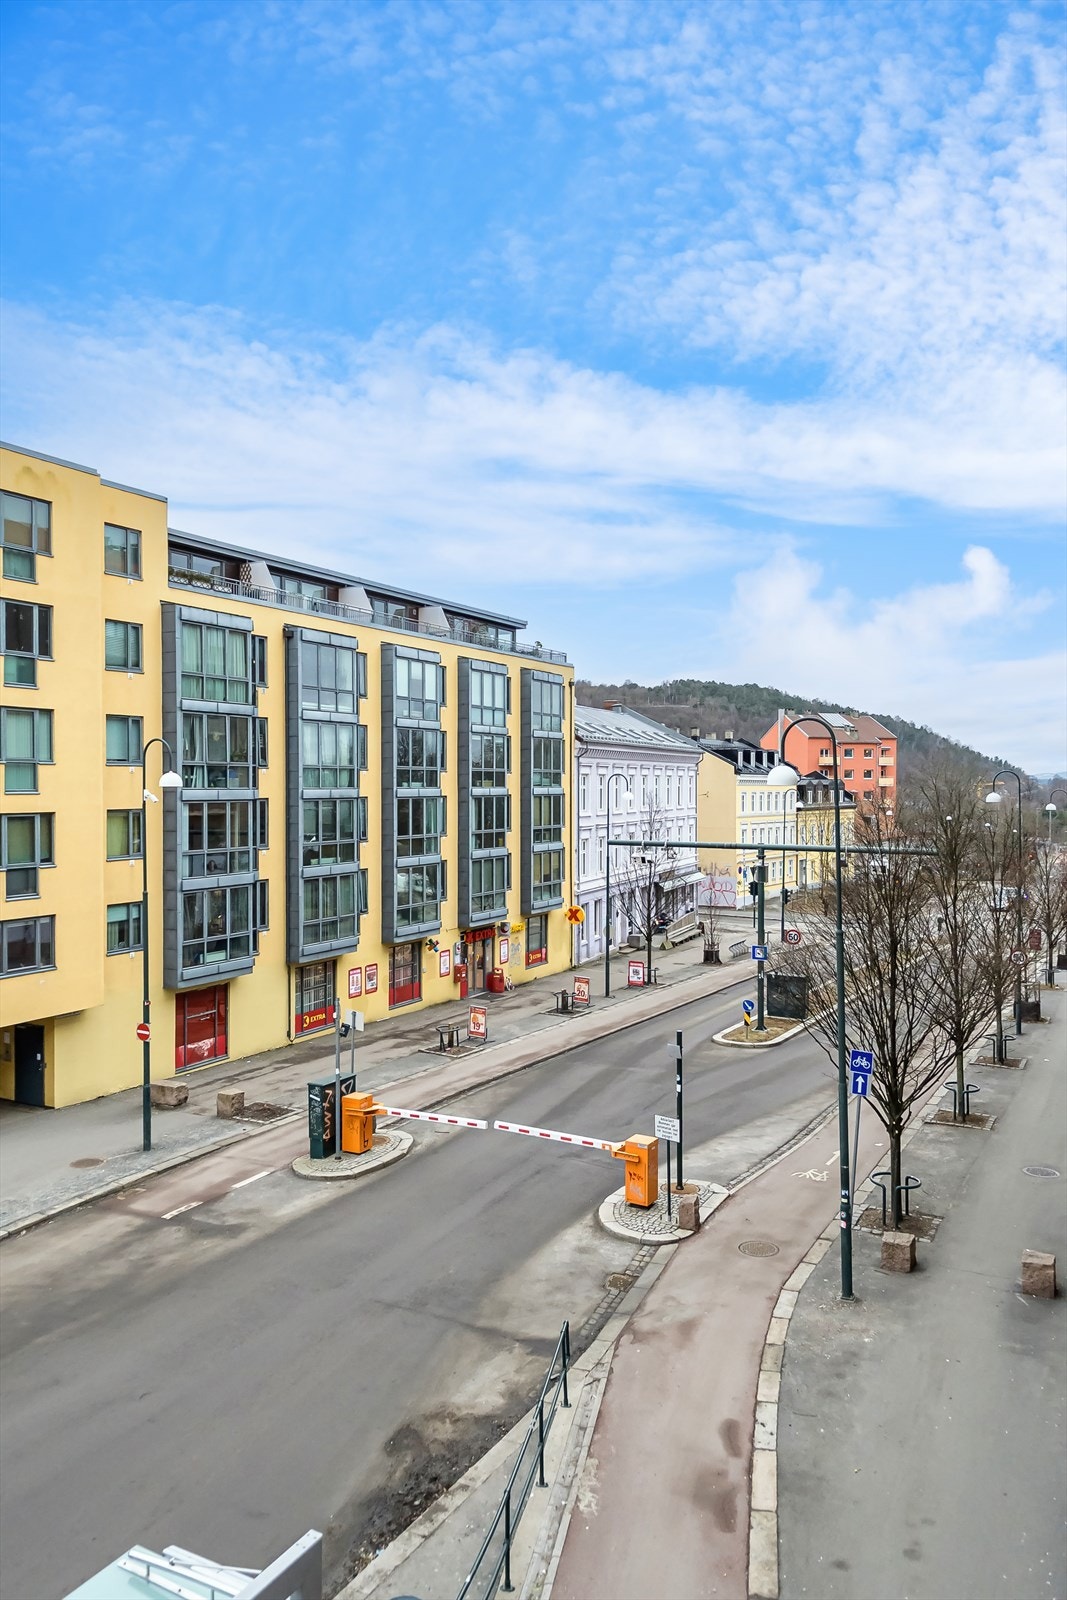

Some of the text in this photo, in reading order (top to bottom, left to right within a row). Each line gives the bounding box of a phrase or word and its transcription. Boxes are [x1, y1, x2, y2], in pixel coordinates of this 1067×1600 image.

[475, 928, 497, 941] EXTRA
[788, 933, 799, 942] 50
[310, 1013, 326, 1023] EXTRA
